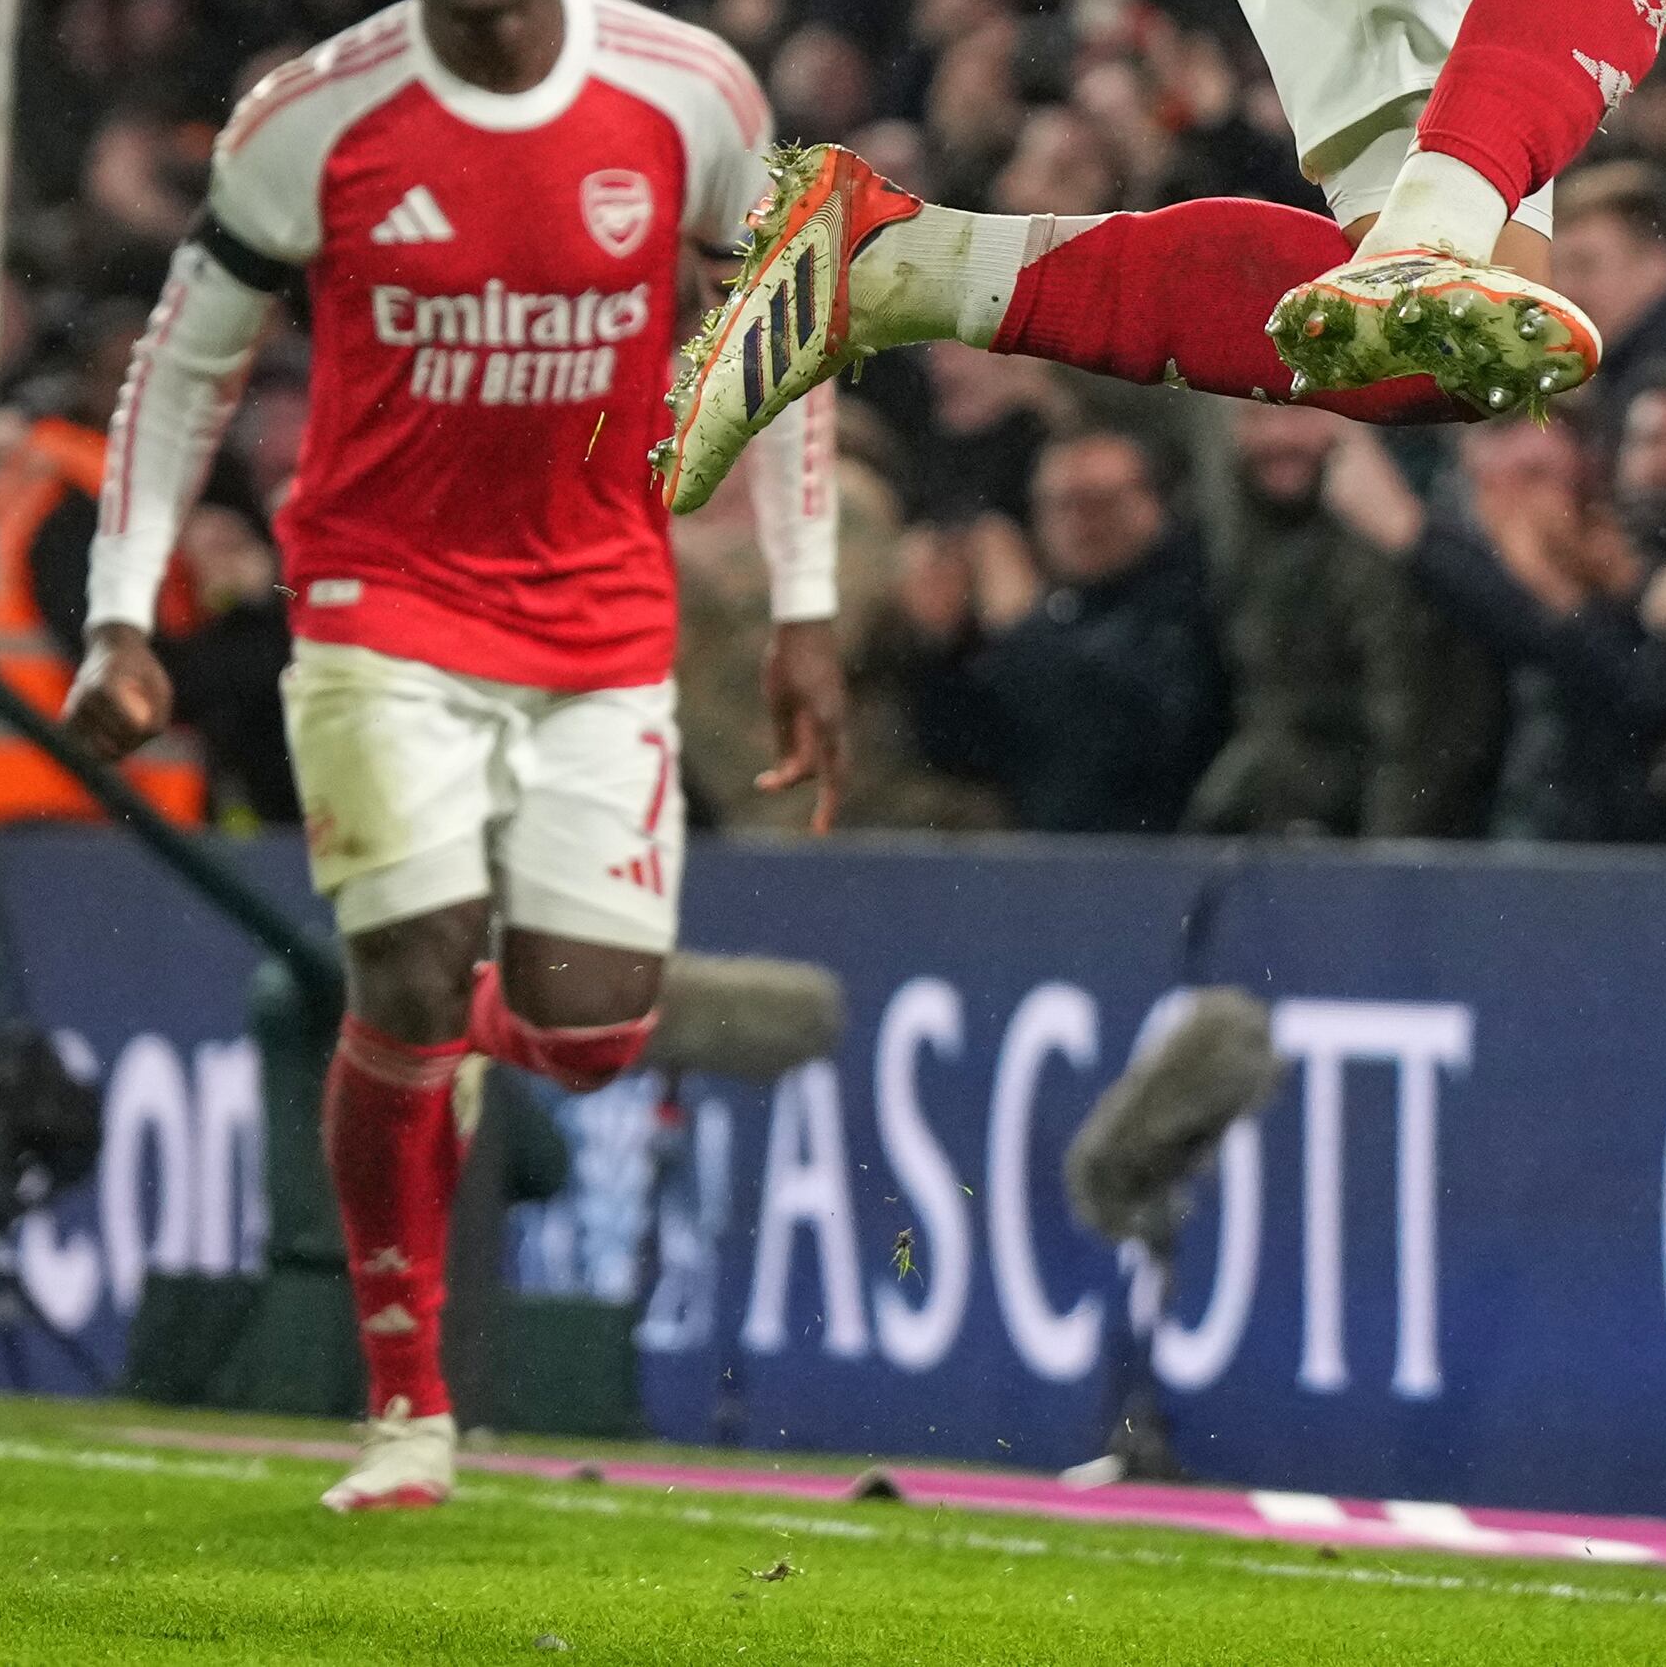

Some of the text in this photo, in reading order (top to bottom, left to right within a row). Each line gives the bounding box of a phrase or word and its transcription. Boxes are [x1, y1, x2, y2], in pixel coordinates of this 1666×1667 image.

[371, 278, 650, 346] Emirates
[409, 346, 616, 407] FLY BETTER
